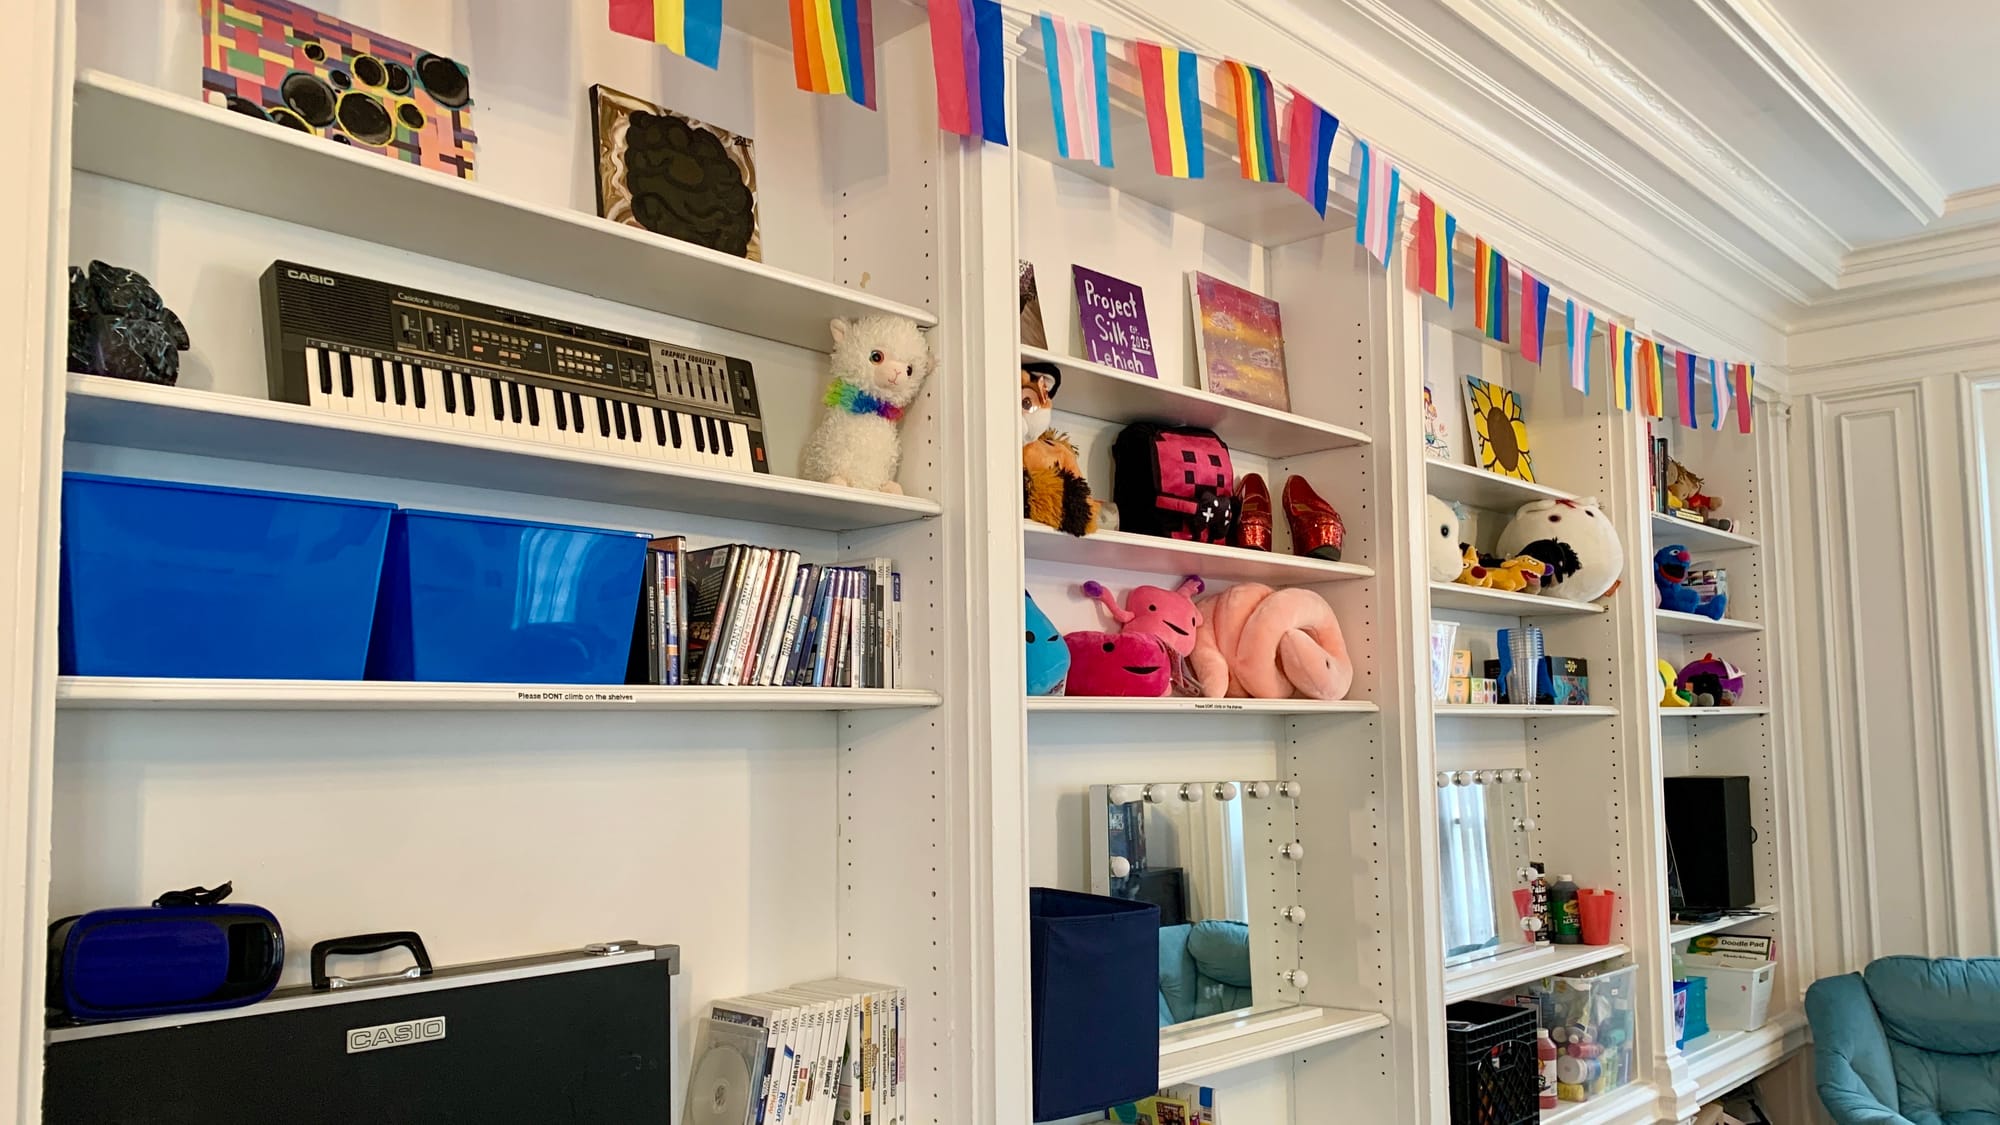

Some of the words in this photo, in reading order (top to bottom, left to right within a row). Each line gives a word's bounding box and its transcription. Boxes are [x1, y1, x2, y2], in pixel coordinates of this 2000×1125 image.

[287, 269, 335, 286] CASIO
[1084, 279, 1137, 319] Project
[1095, 314, 1129, 348] Silk
[1130, 334, 1151, 350] 2017
[660, 349, 687, 361] GRAPHIC
[687, 354, 717, 367] EQUALIZER
[1091, 339, 1145, 373] Lehigh
[788, 614, 799, 635] JUST
[518, 692, 541, 700] Please
[543, 692, 563, 700] DONT
[564, 692, 584, 700] climb
[1721, 939, 1748, 948] Doodle
[1749, 940, 1765, 948] Pad
[799, 1012, 808, 1028] Wii
[807, 1014, 816, 1029] Wii
[816, 1012, 825, 1027] Wii
[825, 1010, 834, 1025] Wii
[834, 1008, 842, 1024] Wii
[842, 1006, 851, 1021] Wii
[770, 1020, 780, 1035] Wii
[780, 1018, 789, 1034] Wii
[790, 1016, 799, 1032] Wii
[350, 1020, 443, 1050] CASIO
[775, 1091, 787, 1124] Resort
